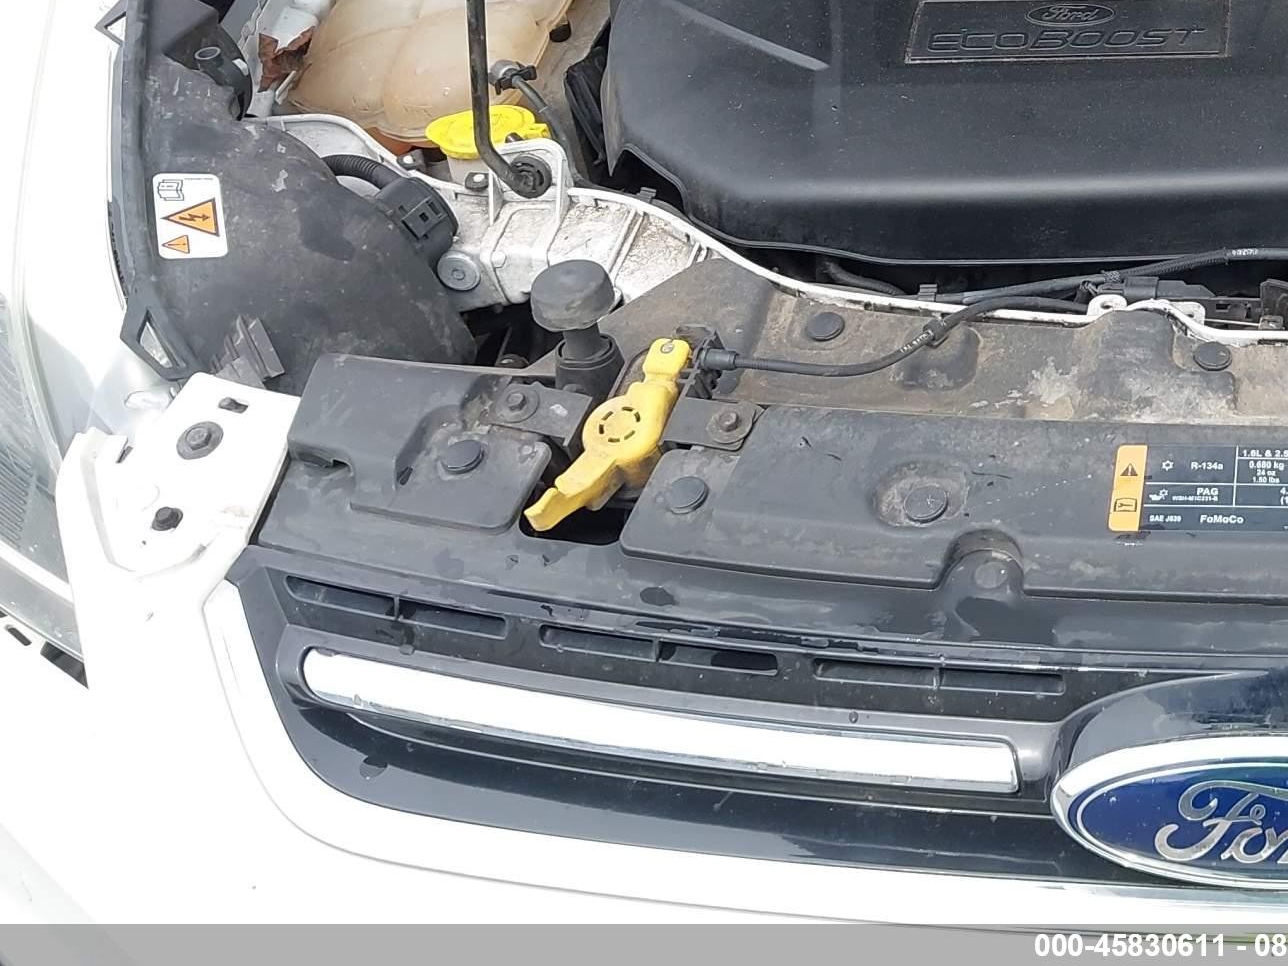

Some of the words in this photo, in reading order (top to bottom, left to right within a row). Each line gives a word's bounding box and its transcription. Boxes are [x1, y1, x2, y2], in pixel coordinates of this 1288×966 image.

[1043, 6, 1099, 22] Ford
[1190, 461, 1224, 470] R-134a
[1273, 460, 1285, 471] kg
[1196, 487, 1219, 495] PAG
[1149, 514, 1164, 522] SAE
[1200, 514, 1245, 524] FoMoCo
